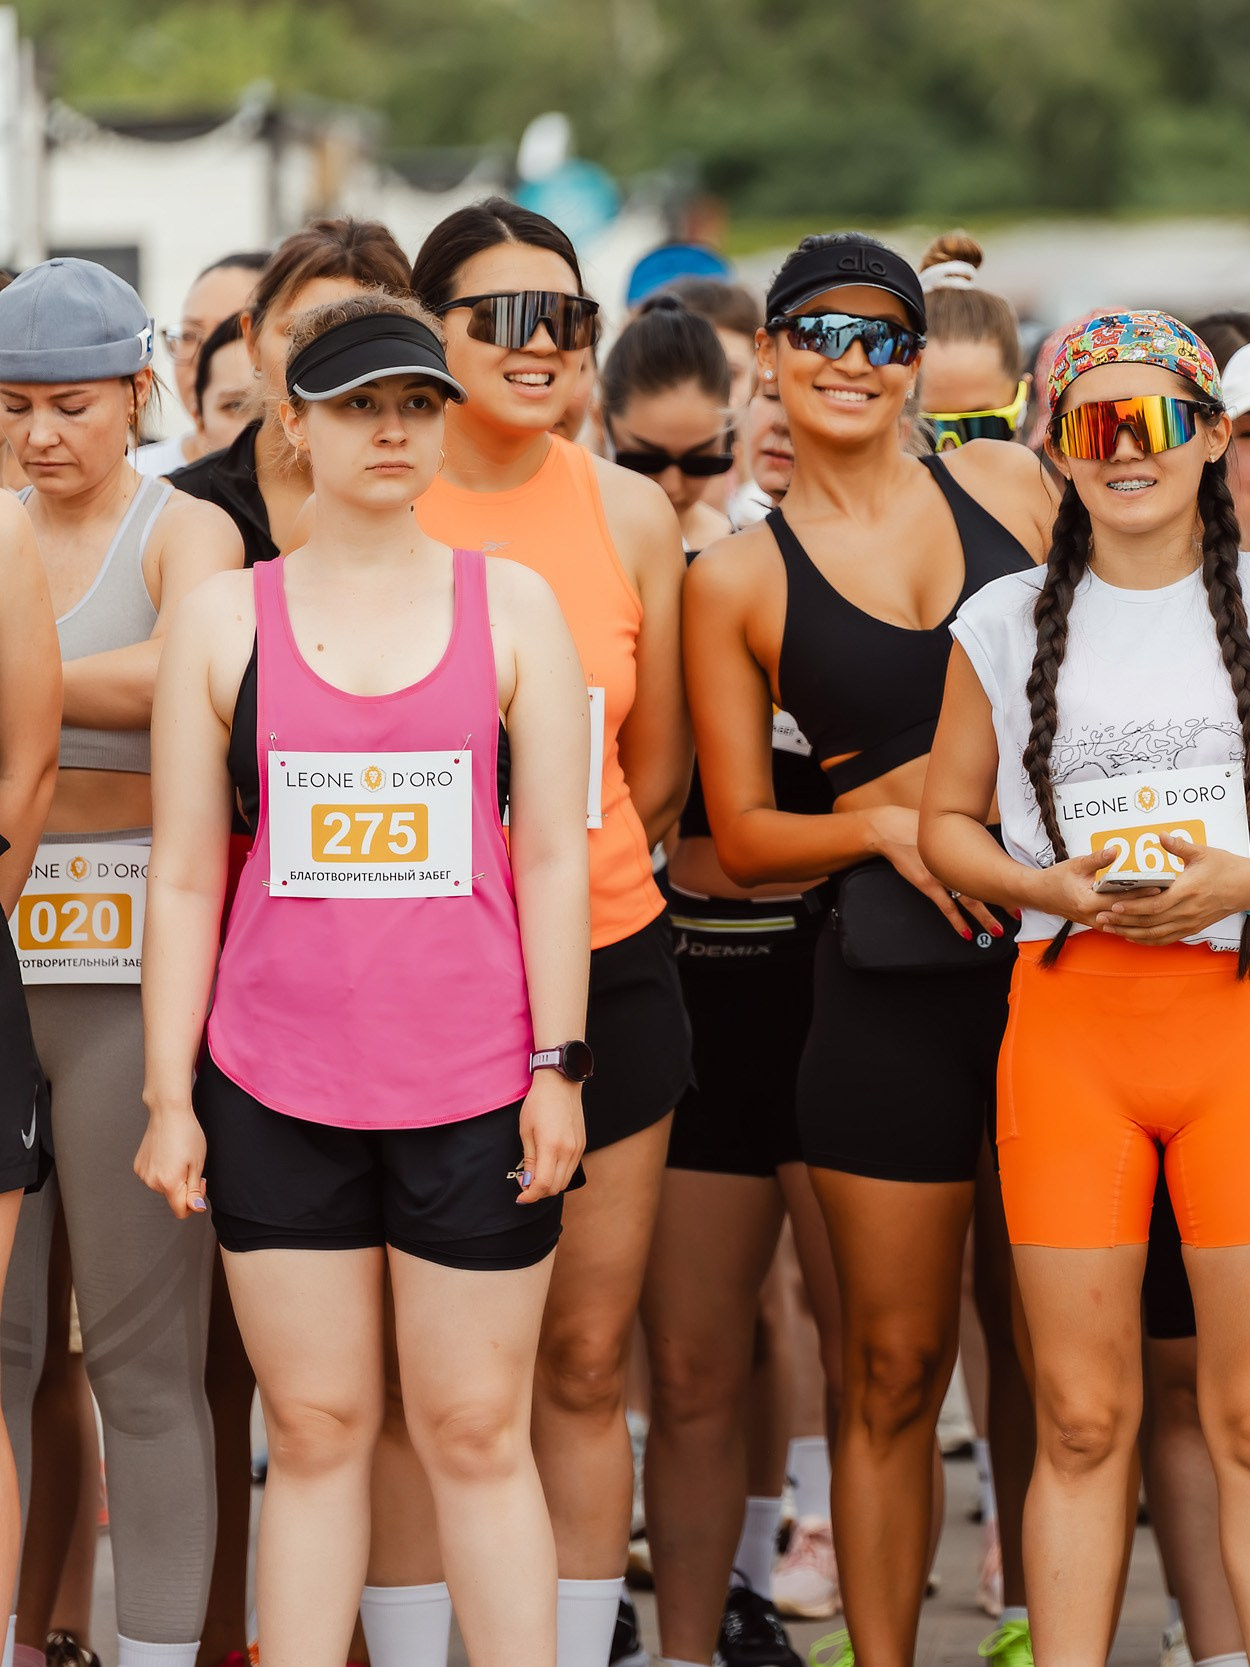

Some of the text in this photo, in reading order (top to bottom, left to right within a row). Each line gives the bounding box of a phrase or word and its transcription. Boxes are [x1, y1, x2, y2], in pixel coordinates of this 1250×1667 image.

[837, 247, 887, 277] alo
[286, 771, 453, 788] LEONE D'ORO
[1062, 785, 1226, 821] LEONE D'ORO
[322, 811, 417, 855] 275
[290, 869, 451, 882] БЛАГОТВОРИТЕЛЬНЫЙ ЗАБЕГ
[29, 900, 120, 943] 020
[122, 958, 142, 968] ЗАБ
